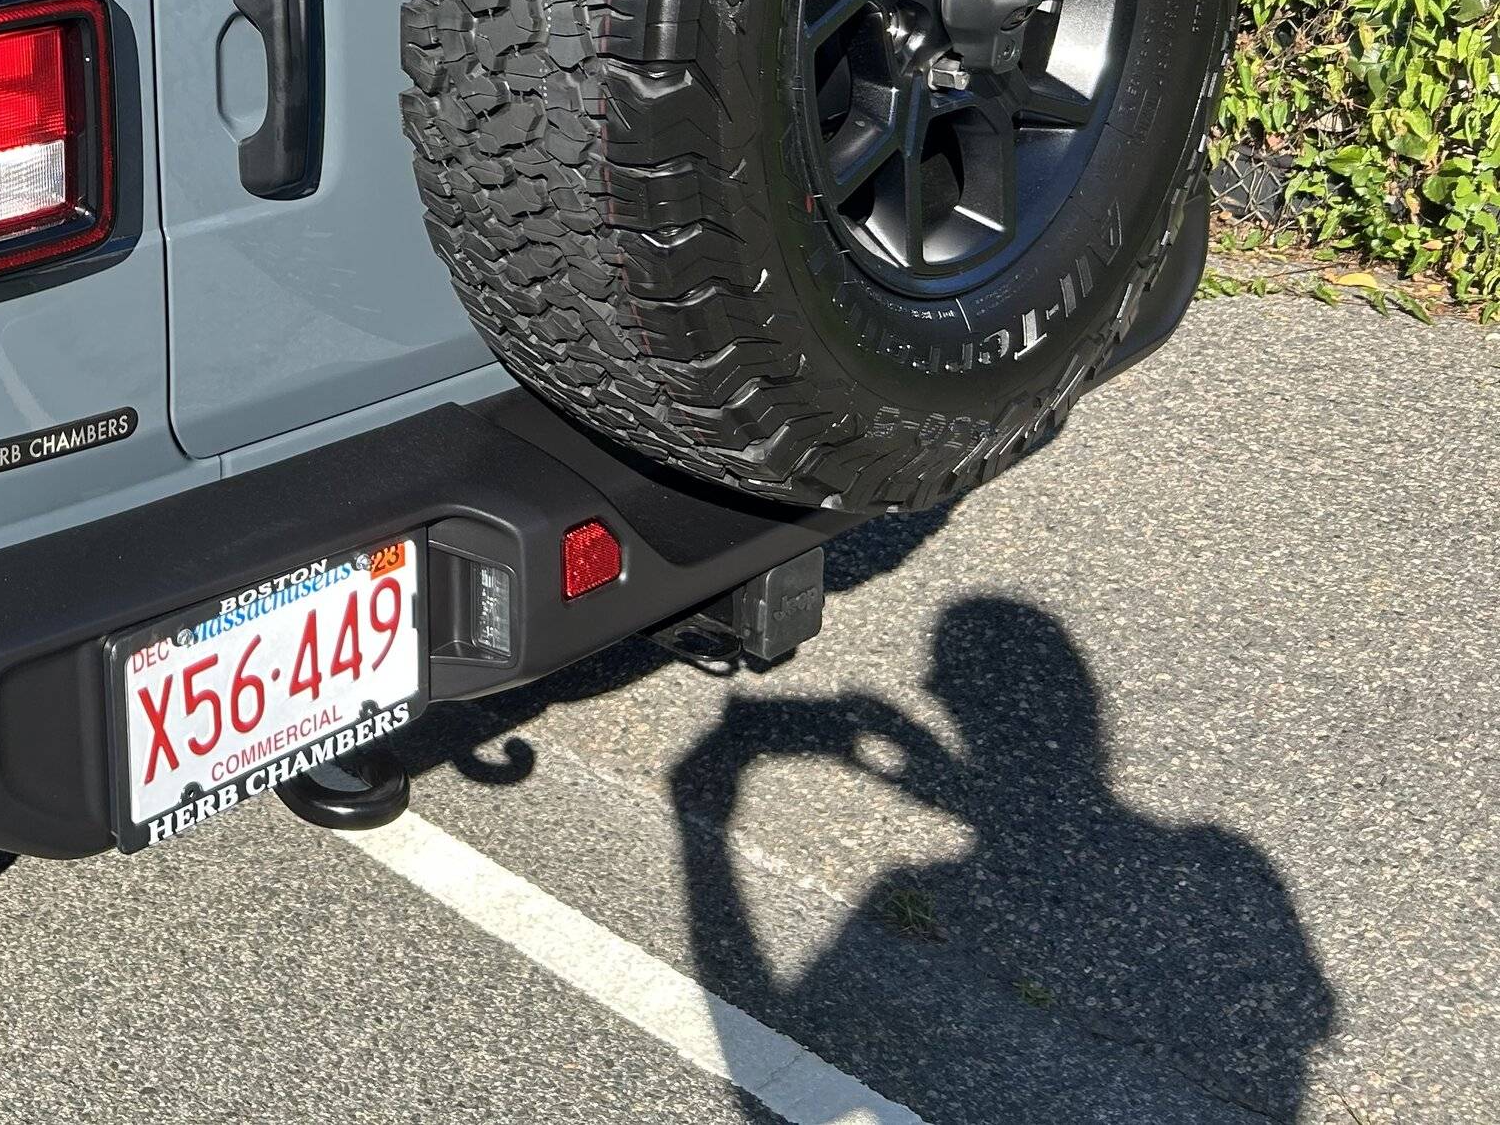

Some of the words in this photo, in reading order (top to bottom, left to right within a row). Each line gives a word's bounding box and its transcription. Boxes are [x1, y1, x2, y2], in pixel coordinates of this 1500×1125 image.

[29, 415, 129, 459] CHAMBERS
[373, 543, 400, 573] 23
[219, 559, 328, 616] BOSTON
[132, 637, 170, 673] DEC
[211, 705, 344, 782] COMMERCIAL
[147, 787, 238, 847] HERB
[245, 702, 411, 799] CHAMBERS
